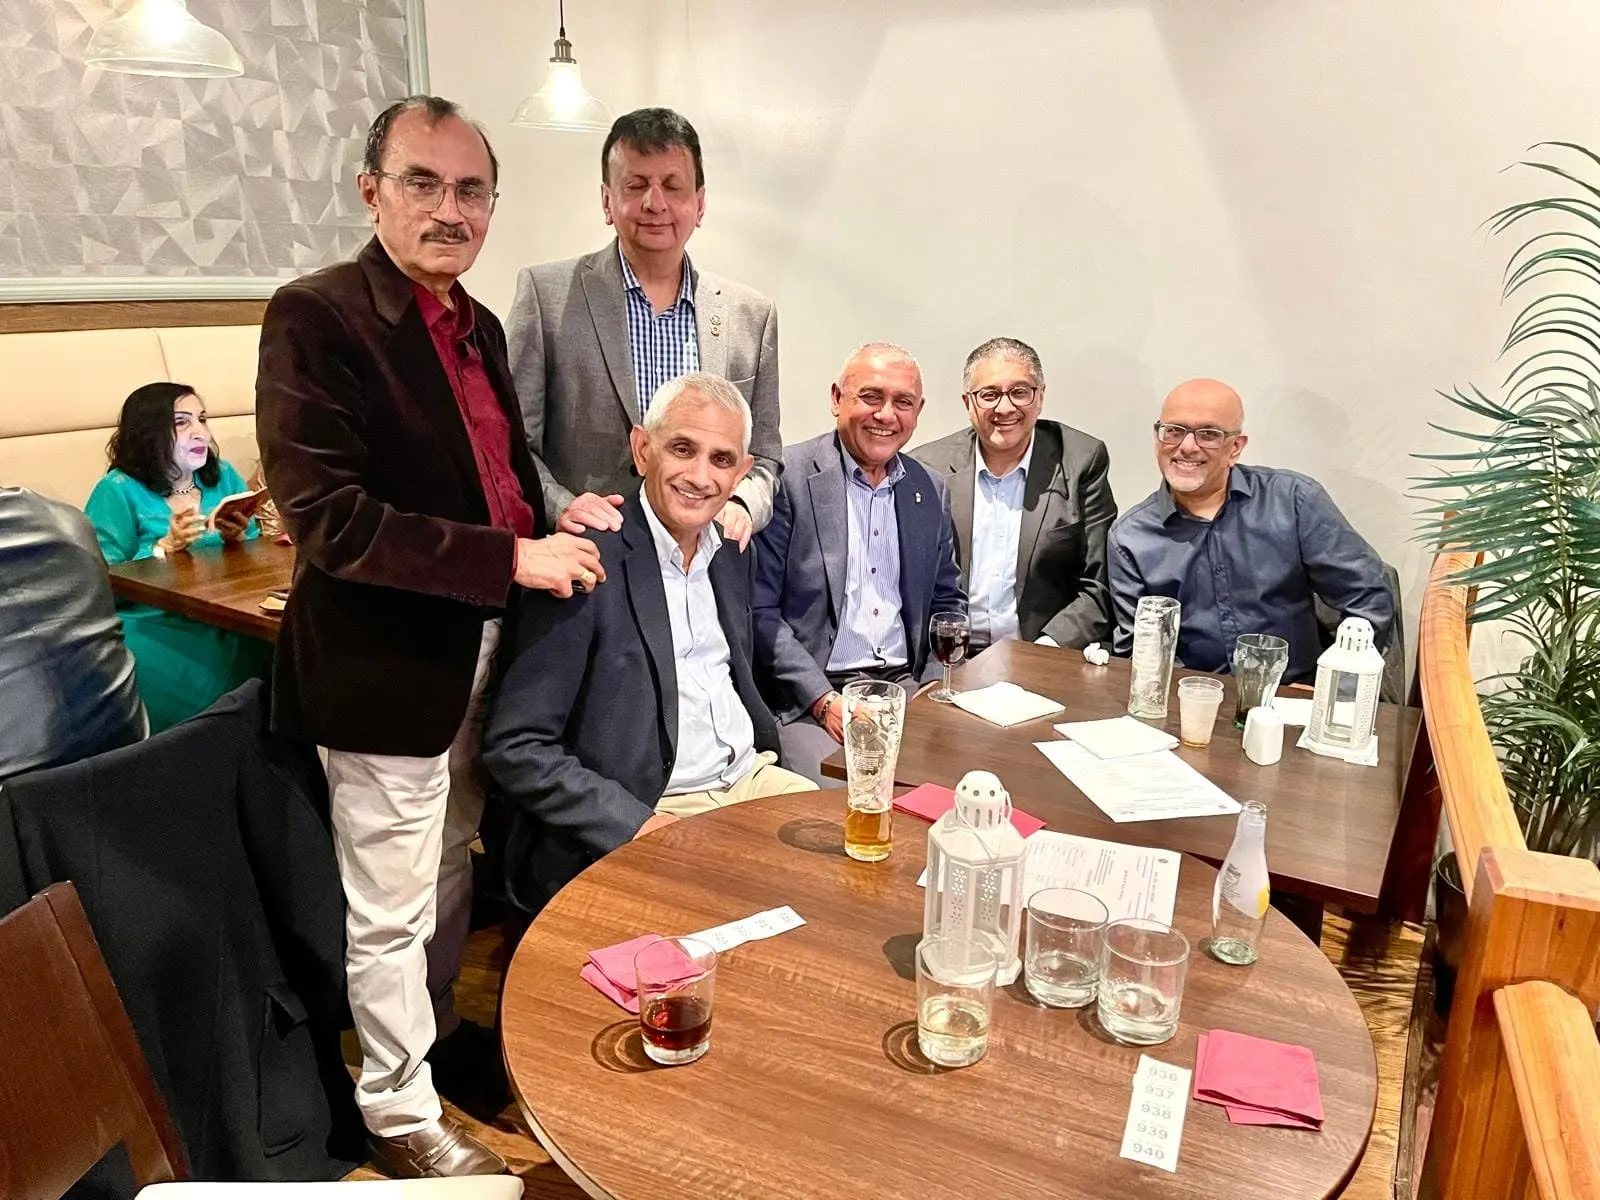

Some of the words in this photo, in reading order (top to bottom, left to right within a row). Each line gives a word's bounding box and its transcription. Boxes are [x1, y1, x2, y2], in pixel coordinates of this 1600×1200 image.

[1149, 1067, 1177, 1082] 936
[1145, 1085, 1174, 1099] 937
[1141, 1104, 1171, 1119] 938
[1137, 1123, 1168, 1139] 939
[1133, 1143, 1164, 1159] 940
